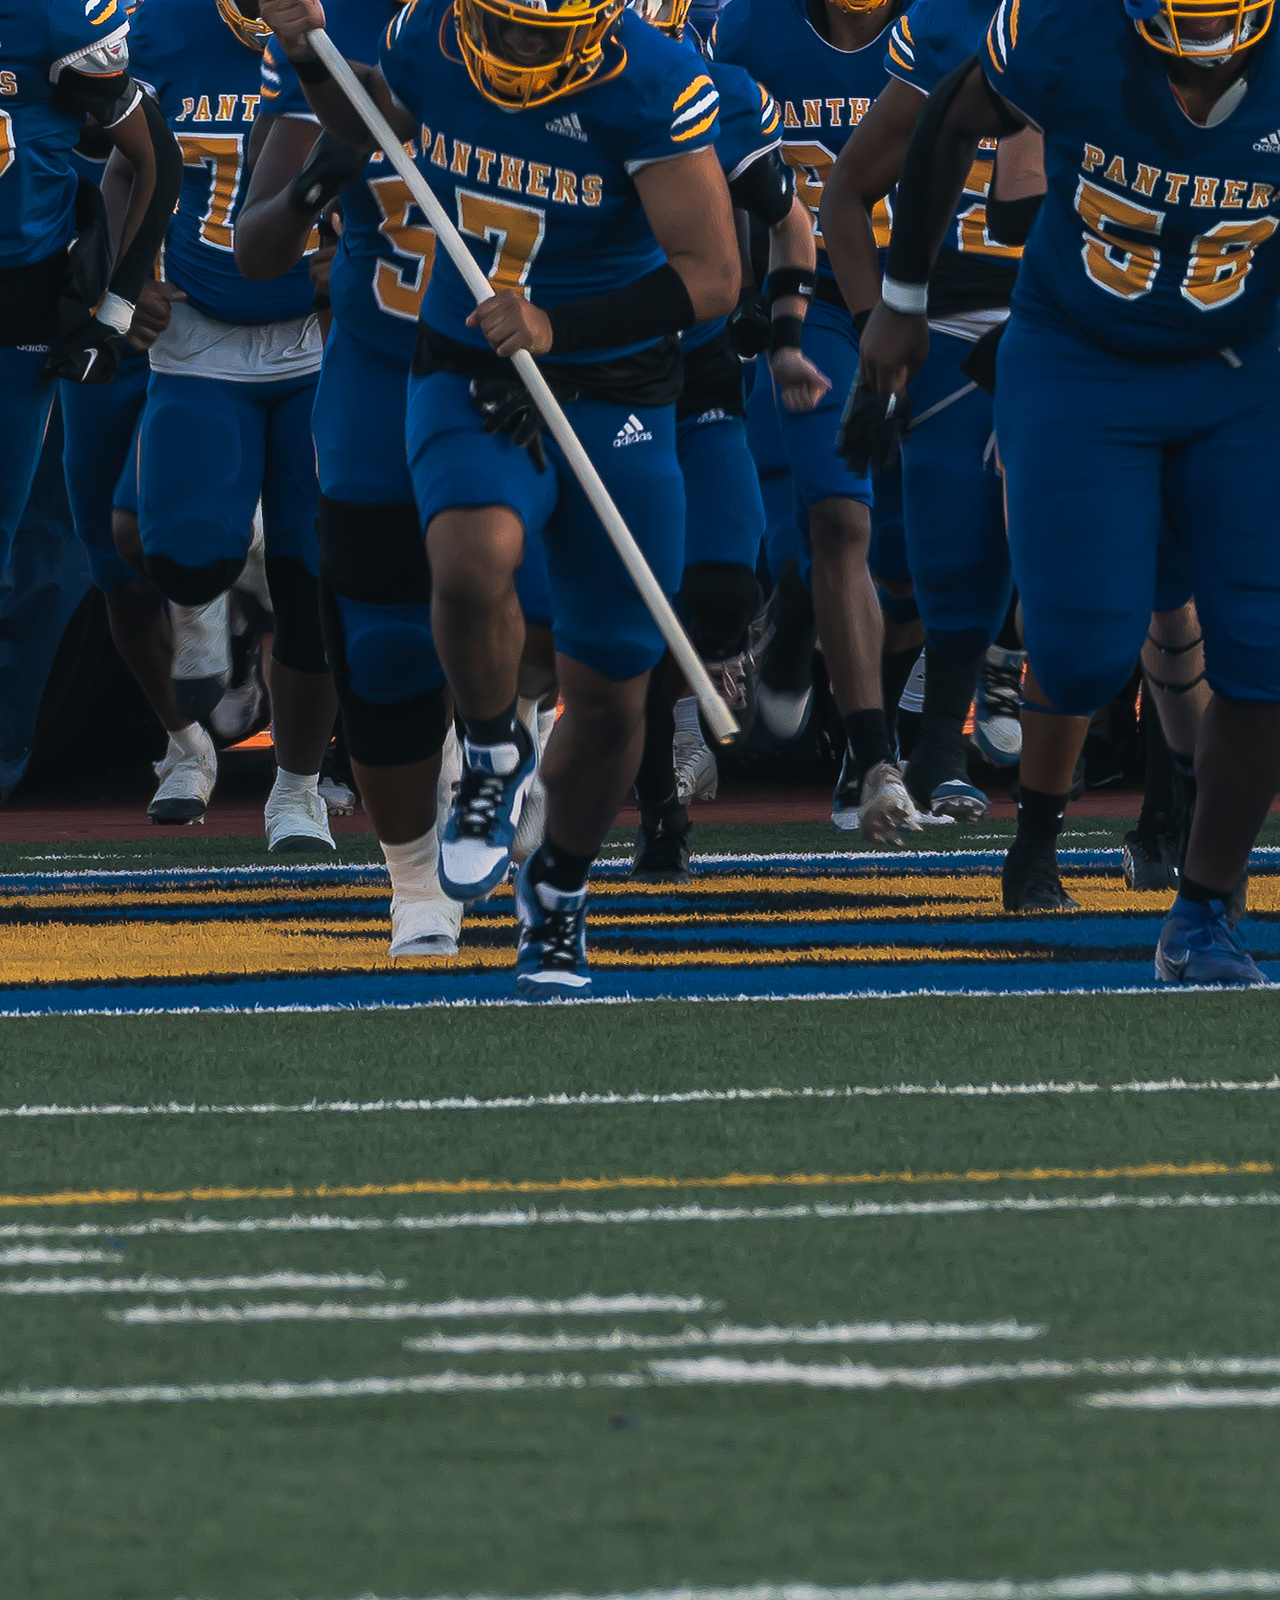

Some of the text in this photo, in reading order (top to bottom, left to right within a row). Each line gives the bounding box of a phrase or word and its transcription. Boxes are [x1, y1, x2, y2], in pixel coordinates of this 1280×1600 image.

[775, 98, 877, 128] ANTH
[421, 122, 604, 207] PANTHERS
[455, 185, 546, 301] 7
[1074, 173, 1280, 312] 56
[612, 431, 653, 448] adidas
